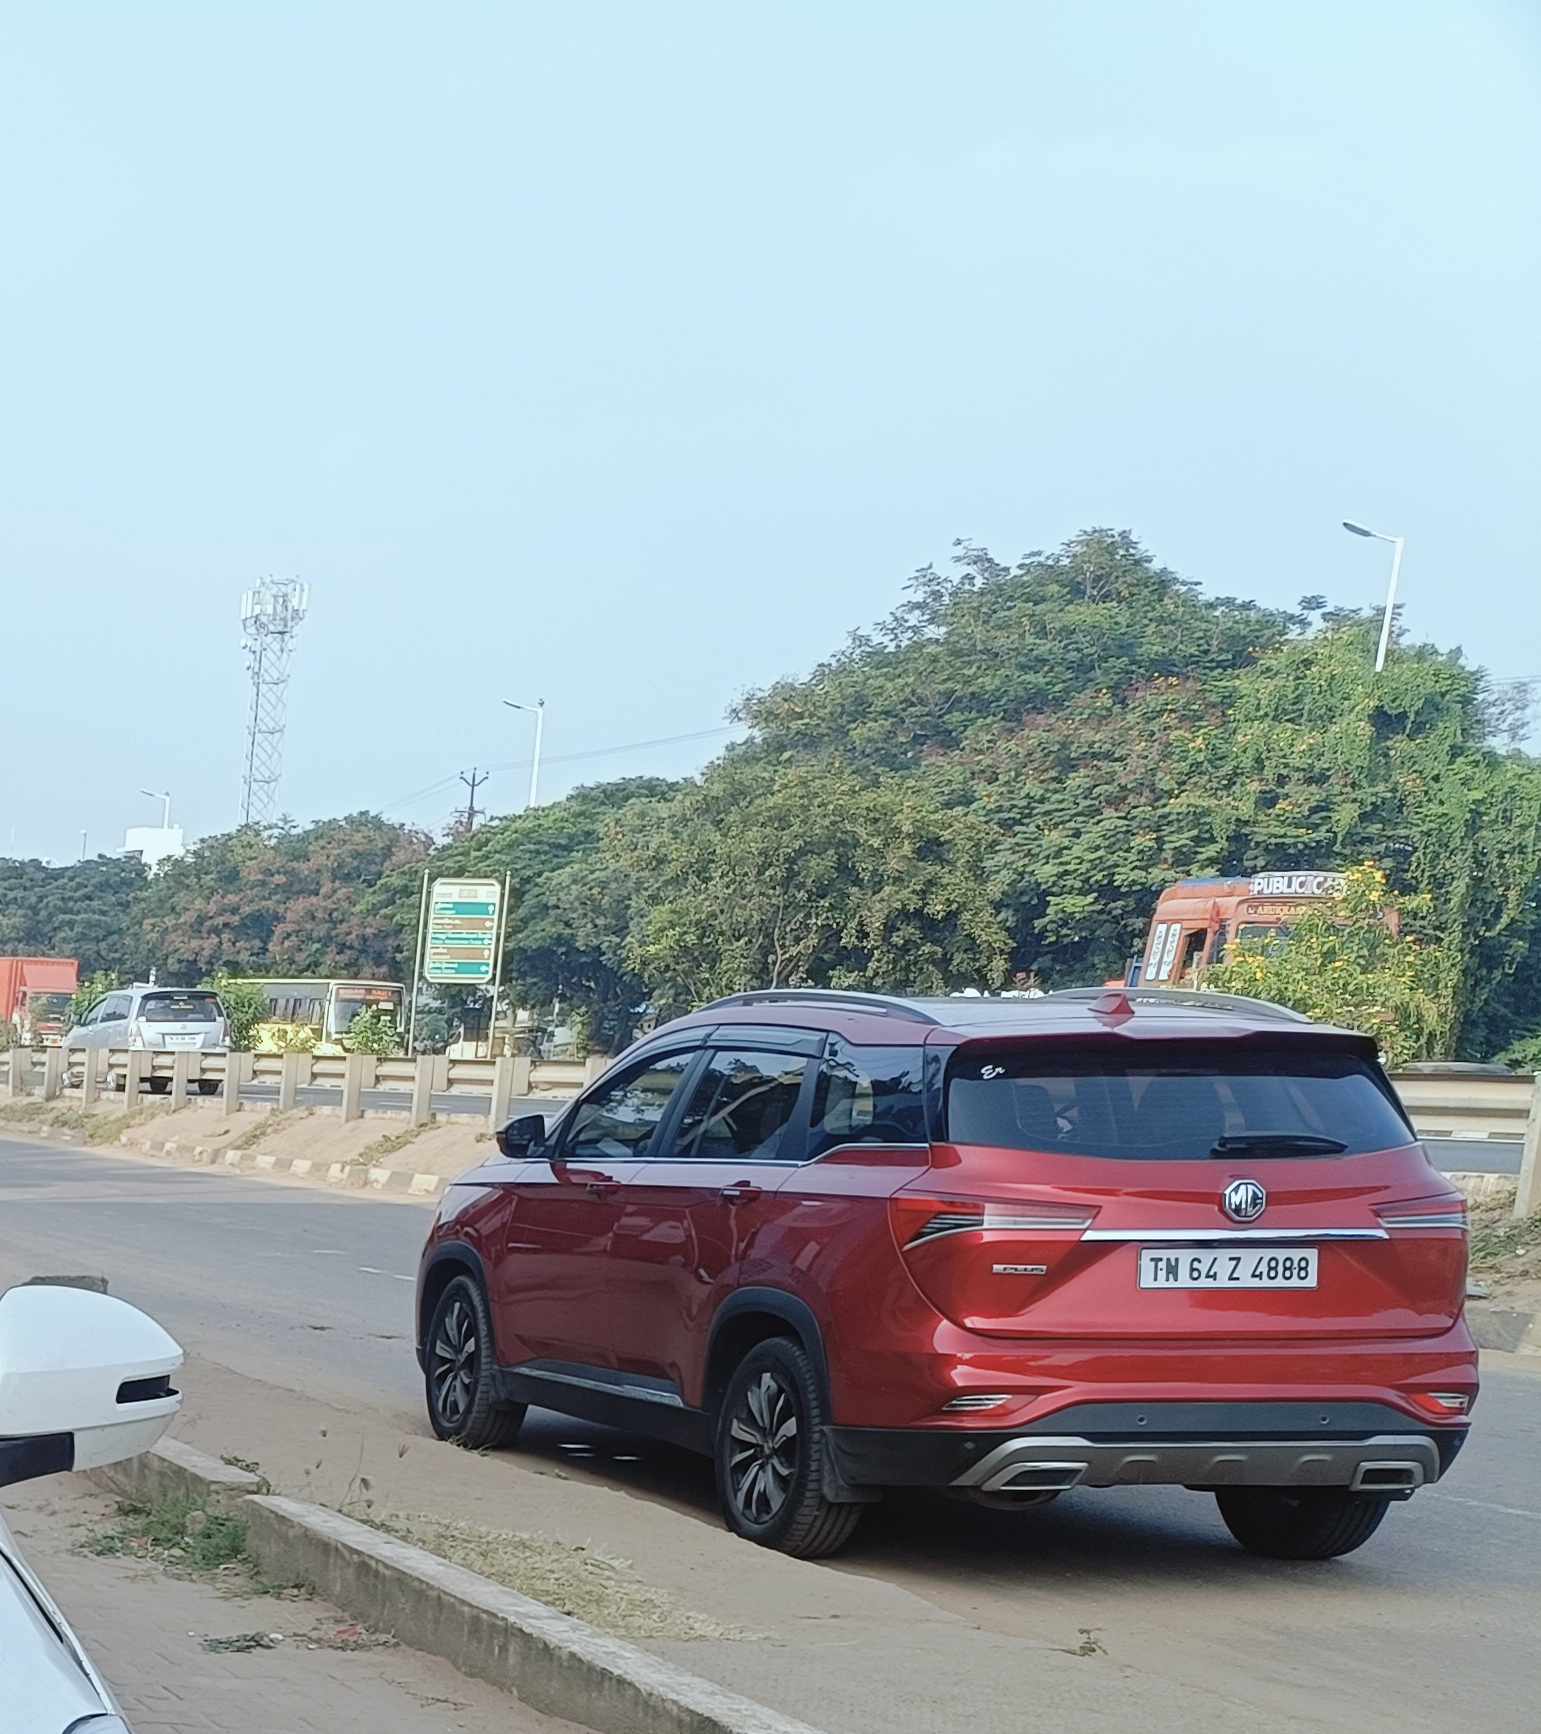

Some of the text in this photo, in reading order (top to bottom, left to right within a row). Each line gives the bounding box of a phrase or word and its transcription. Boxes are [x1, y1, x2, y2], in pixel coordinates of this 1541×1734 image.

[1253, 876, 1306, 895] PUBLIC
[1230, 1184, 1263, 1217] MG
[1150, 1256, 1310, 1282] TN 64 Z 4888
